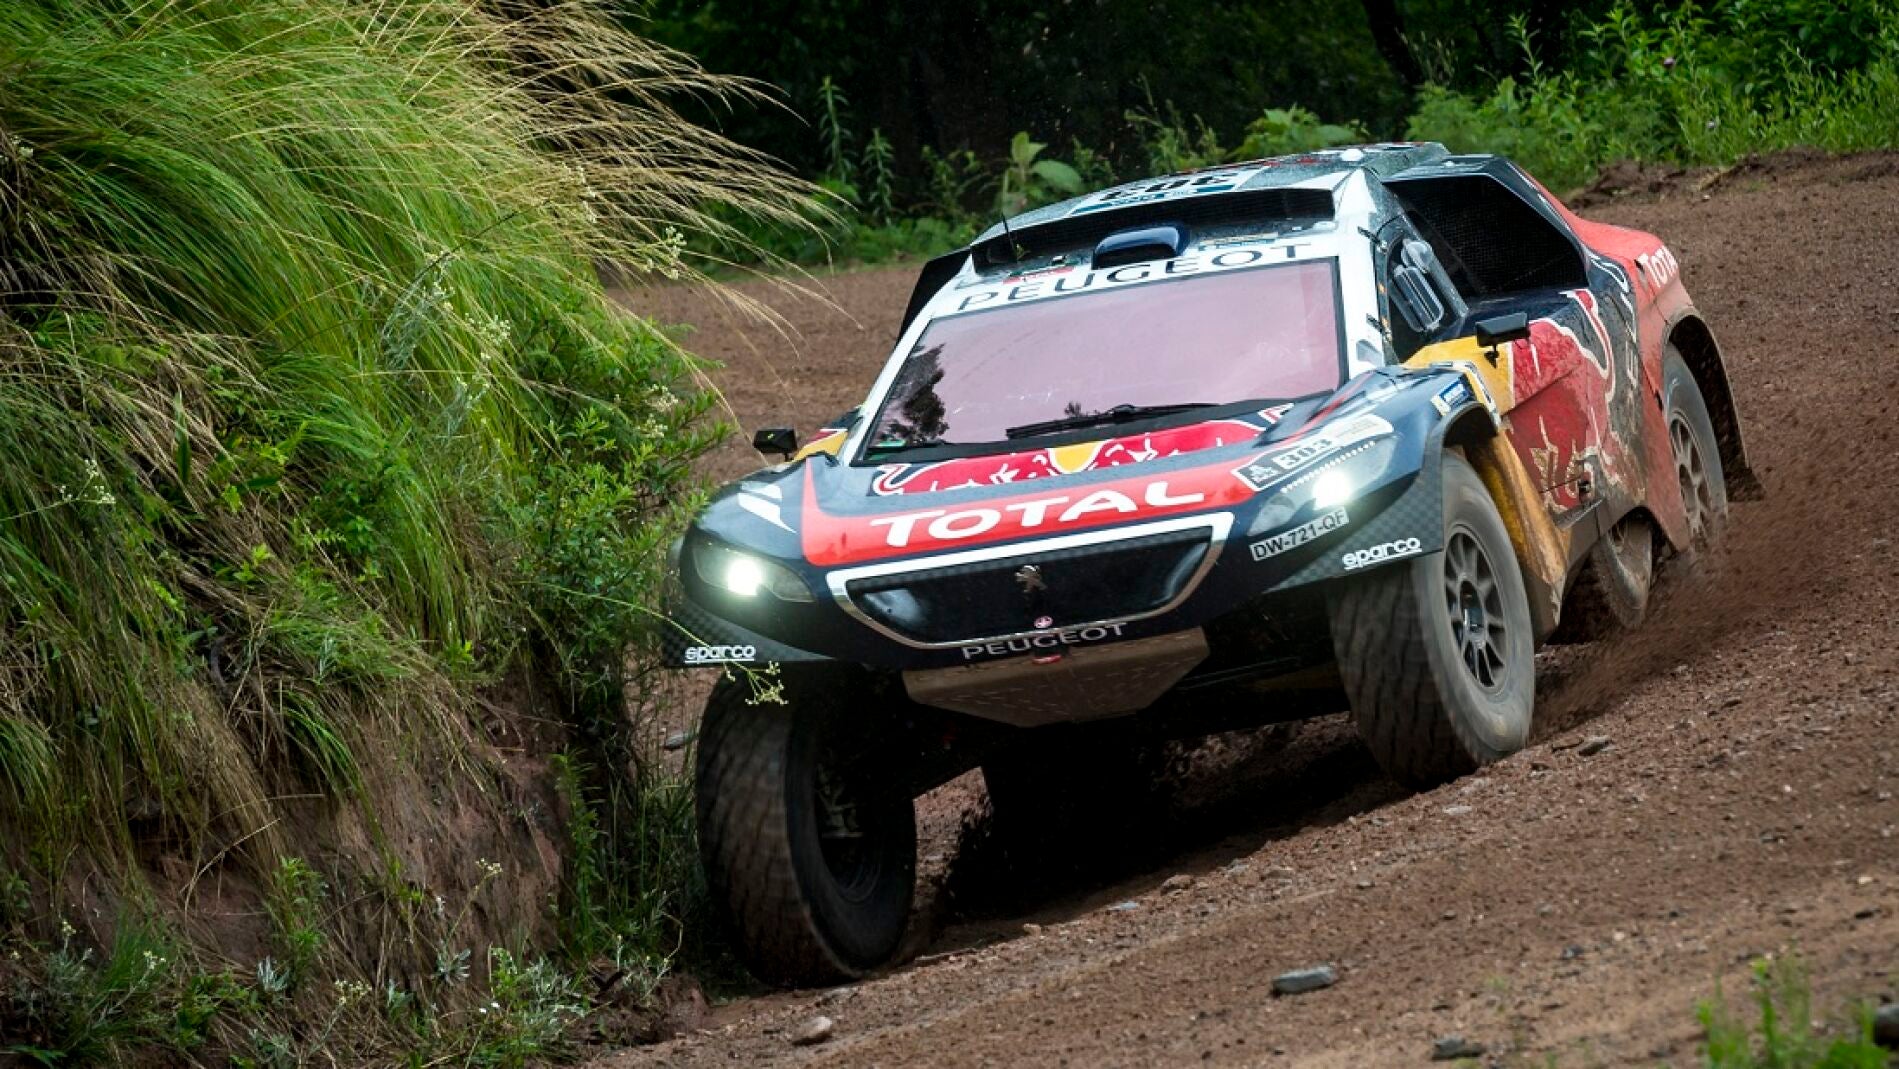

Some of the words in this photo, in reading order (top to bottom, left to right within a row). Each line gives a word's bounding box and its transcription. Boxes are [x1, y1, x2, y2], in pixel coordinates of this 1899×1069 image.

[957, 243, 1312, 311] PEUGEOT
[1280, 437, 1333, 467] 303
[870, 480, 1206, 548] TOTAL
[1253, 509, 1346, 559] DW-721-QF
[1341, 536, 1423, 571] sparco
[684, 644, 757, 665] sparco
[962, 621, 1128, 661] PEUGEOT
